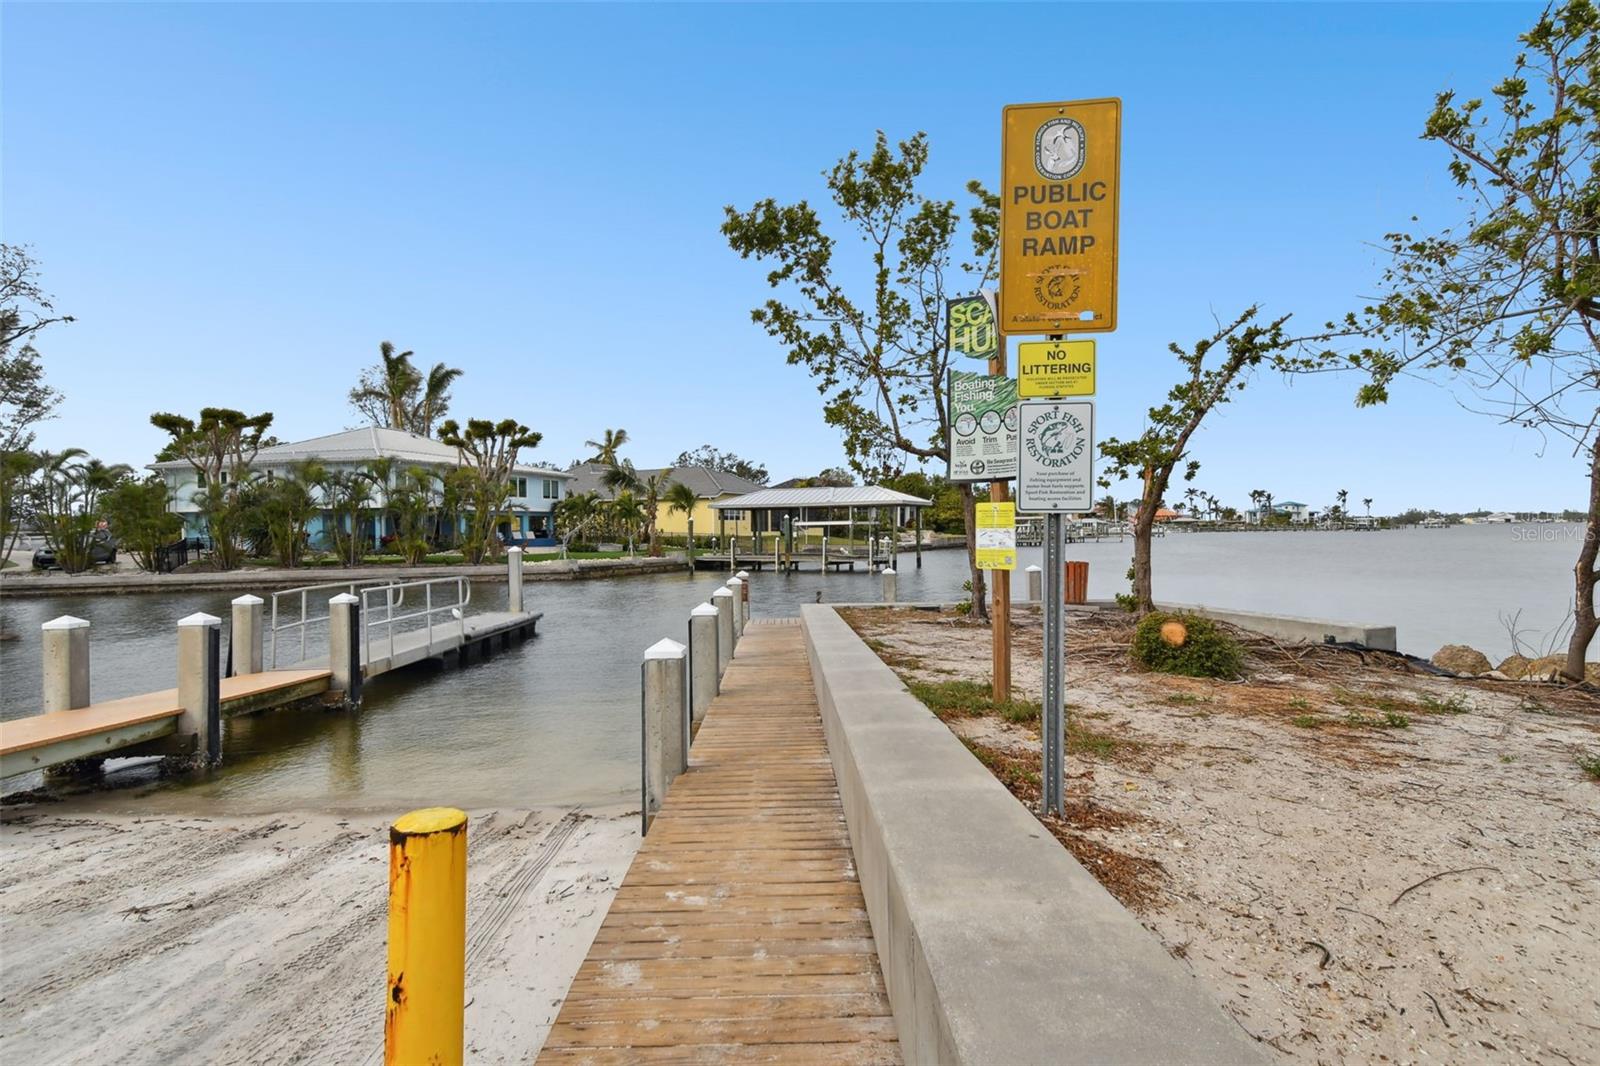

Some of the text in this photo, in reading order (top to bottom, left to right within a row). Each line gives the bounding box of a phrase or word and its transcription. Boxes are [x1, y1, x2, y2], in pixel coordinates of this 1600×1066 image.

[1013, 181, 1107, 205] PUBLIC
[1026, 208, 1093, 231] BOAT
[1022, 235, 1096, 257] RAMP
[1034, 285, 1080, 310] RESTORATION
[1046, 350, 1067, 361] NO
[1022, 362, 1091, 375] LITTERING
[1027, 410, 1084, 435] SPORT FISH
[982, 435, 998, 443] Trim
[1026, 437, 1086, 467] RESTORATION
